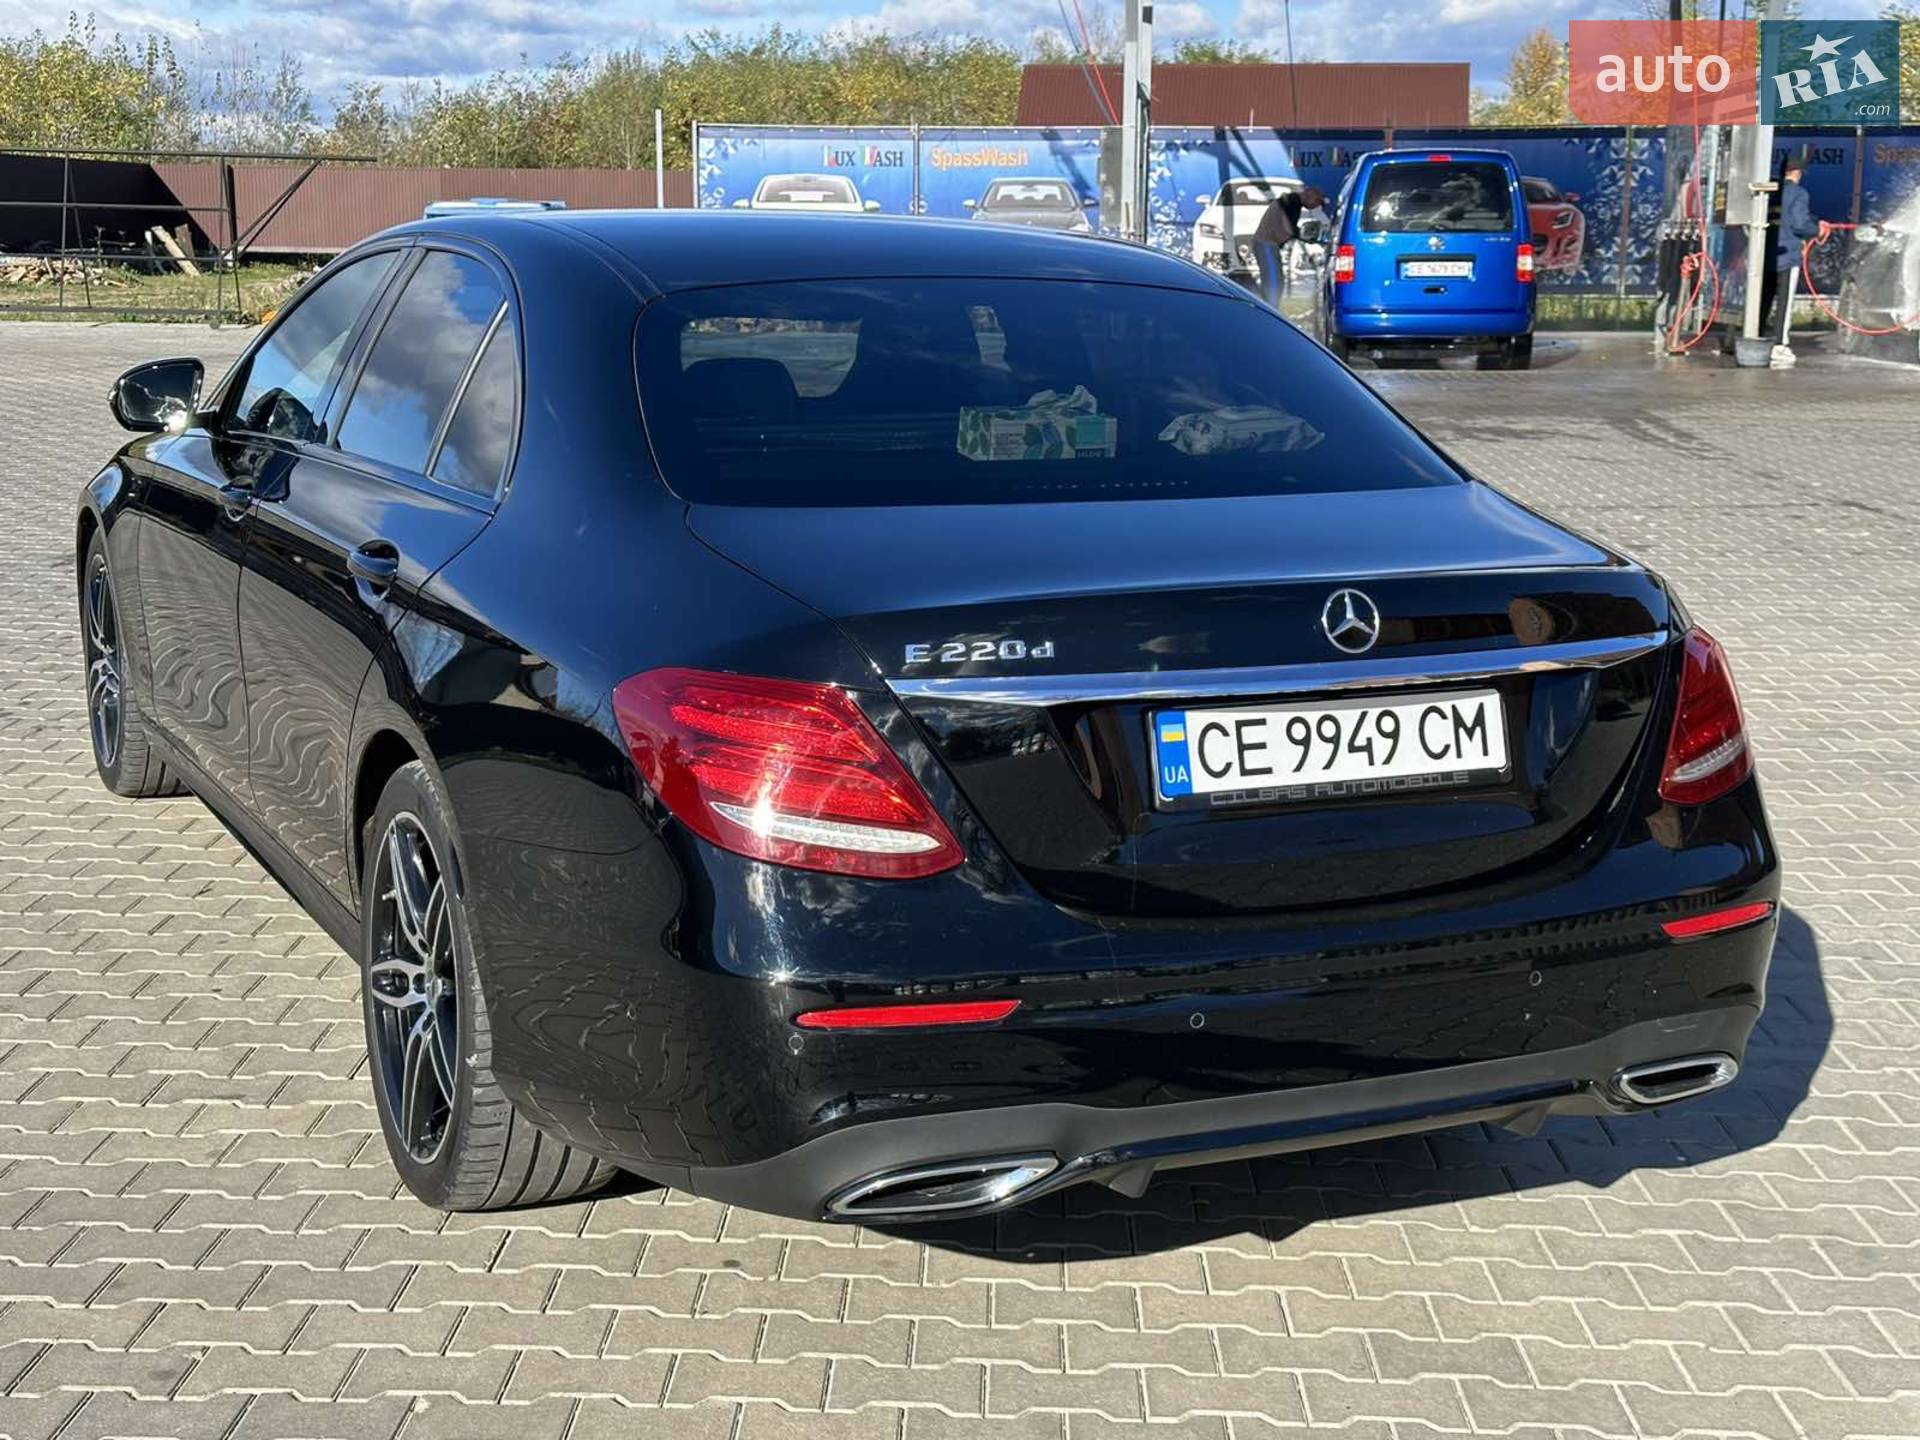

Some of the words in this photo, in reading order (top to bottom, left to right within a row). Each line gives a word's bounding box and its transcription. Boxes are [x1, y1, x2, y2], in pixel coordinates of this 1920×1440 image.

[822, 145, 856, 168] LUX
[930, 147, 1029, 171] SpassWash
[904, 643, 931, 663] E
[1198, 718, 1273, 779] CE
[1286, 709, 1401, 773] 9949
[1418, 702, 1489, 760] CM
[1164, 765, 1189, 784] UA
[1314, 771, 1469, 796] AUTOMOBILE
